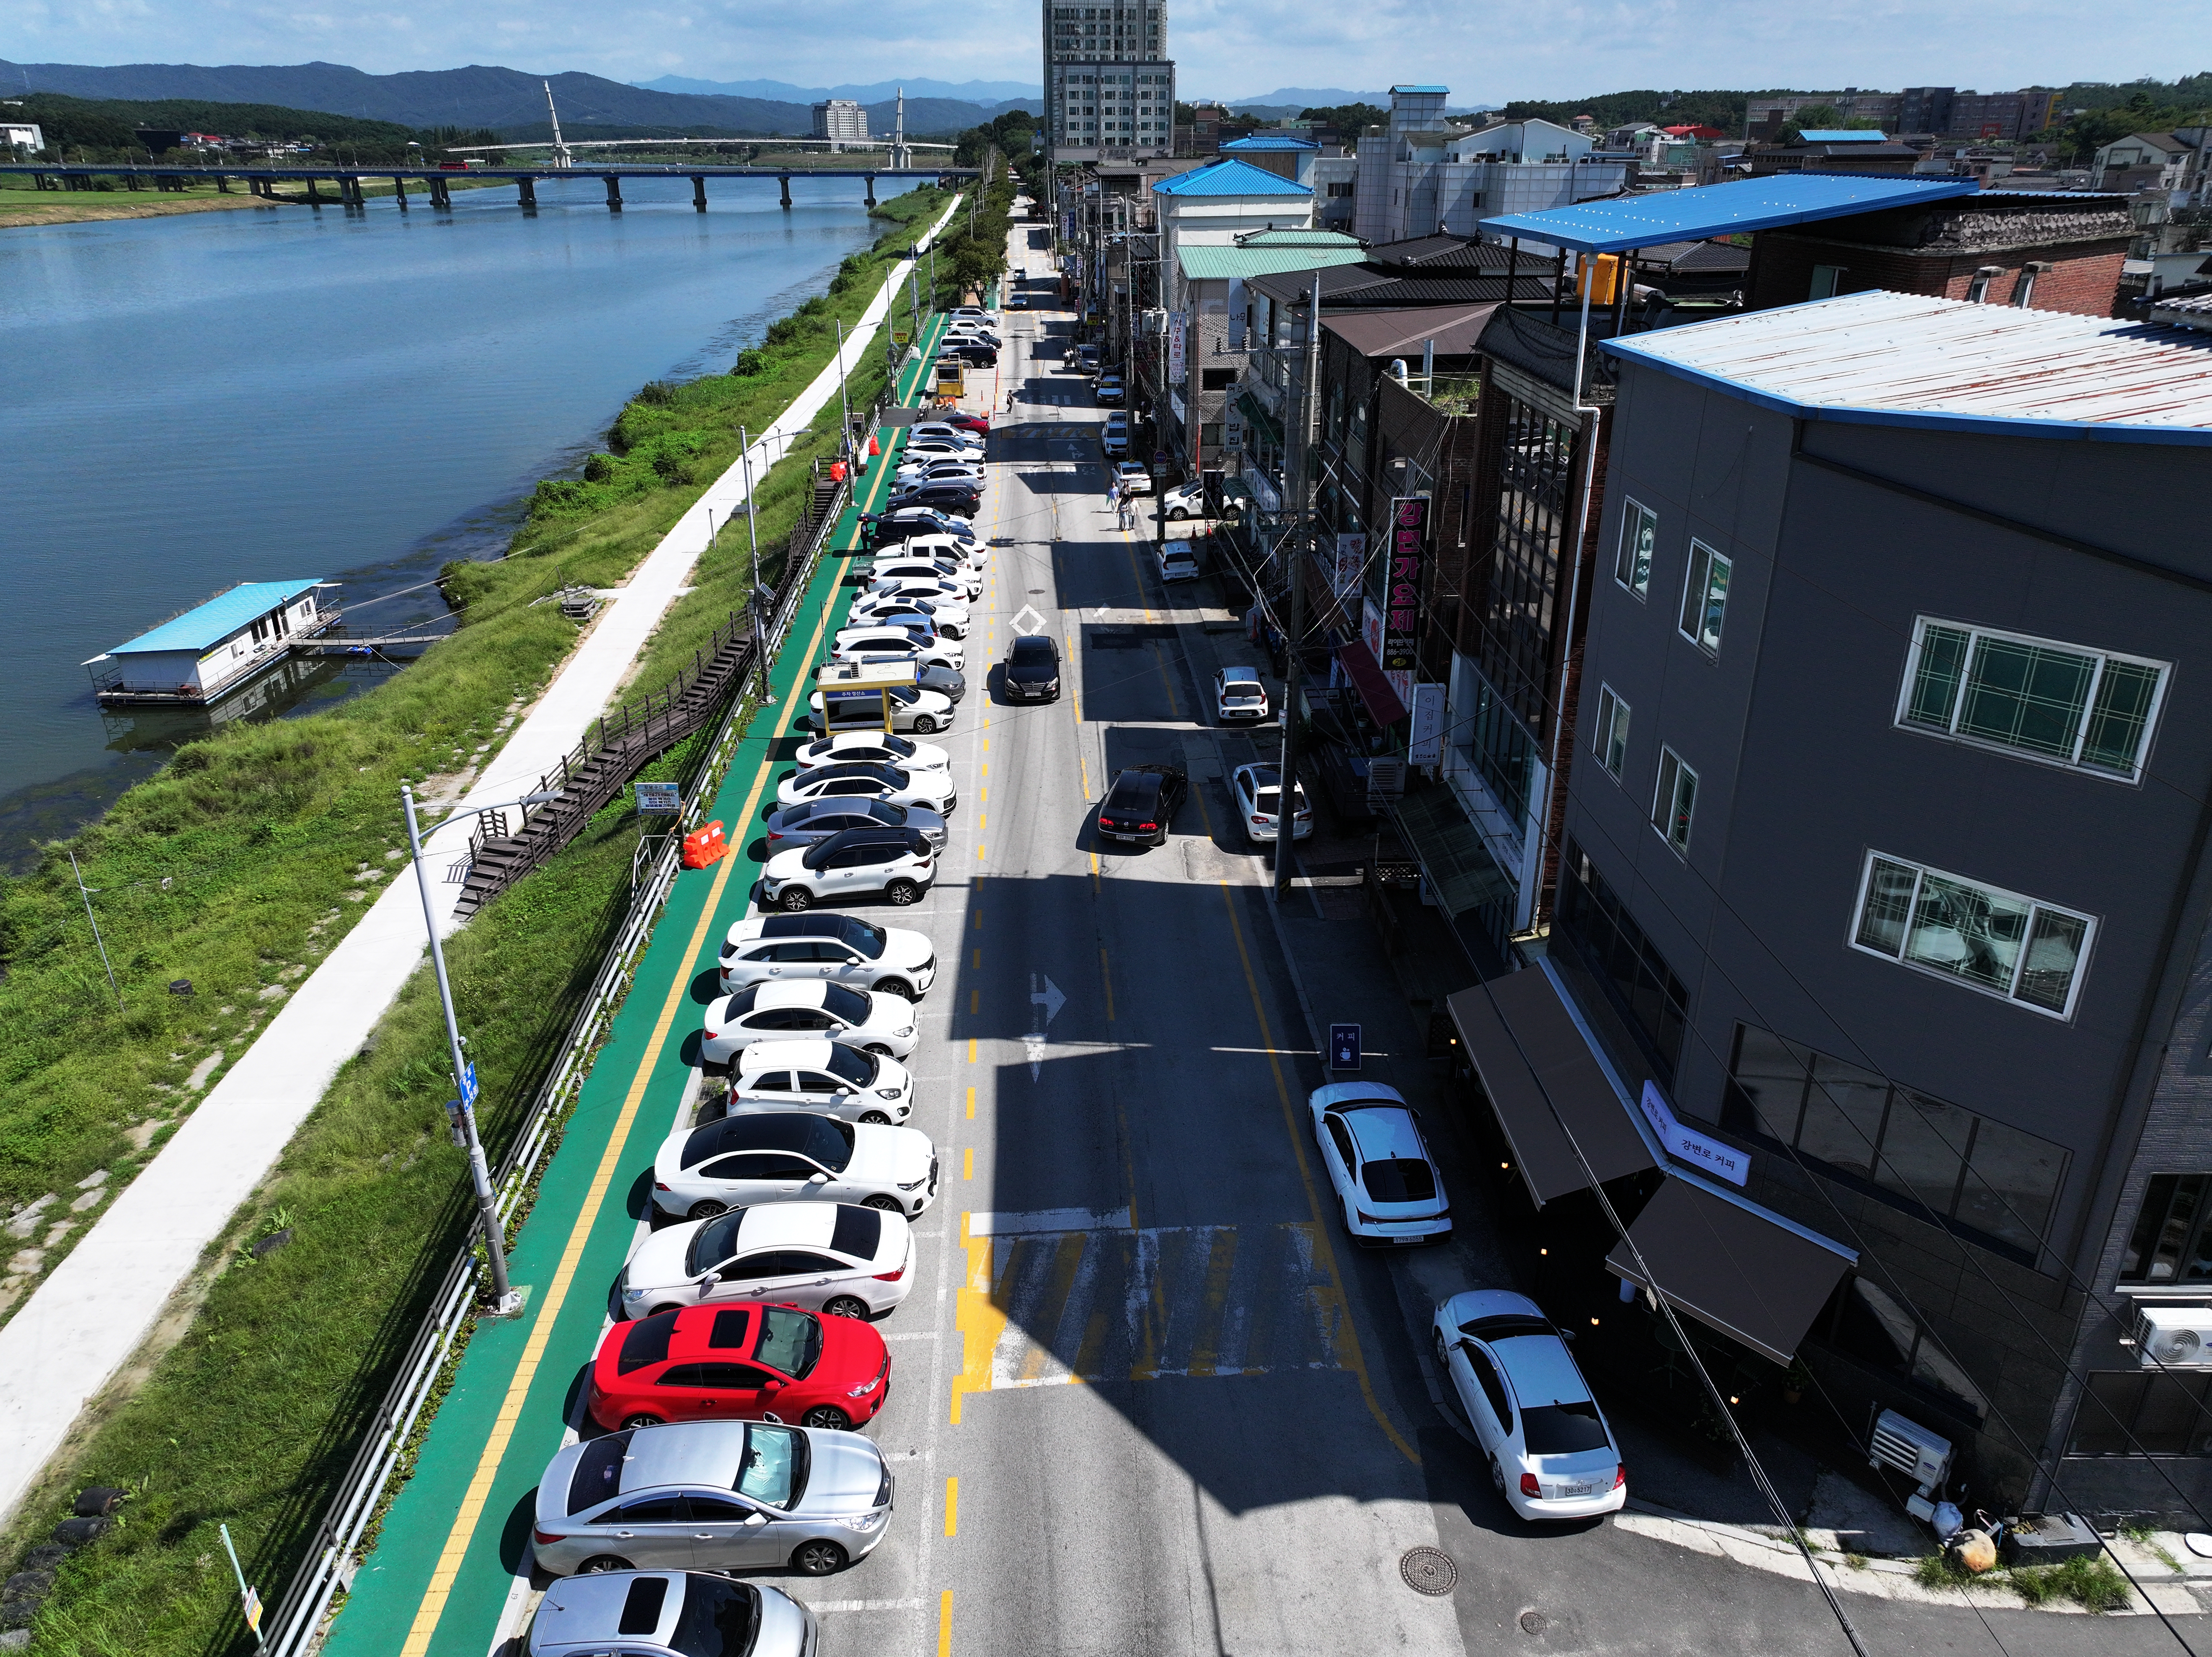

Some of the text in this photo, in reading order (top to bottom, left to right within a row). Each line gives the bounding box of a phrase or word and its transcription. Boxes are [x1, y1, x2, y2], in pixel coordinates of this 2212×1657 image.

[1230, 312, 1245, 323] 나무
[1173, 319, 1182, 358] 사주&타로
[1389, 503, 1424, 631] 강변가요제
[1422, 695, 1434, 748] 이집커피
[1336, 1032, 1355, 1041] 커피
[462, 1067, 472, 1086] 유료
[465, 1084, 478, 1108] 주차장
[1646, 1097, 1667, 1134] 강변로 커피
[1681, 1139, 1735, 1171] 강변로 커피
